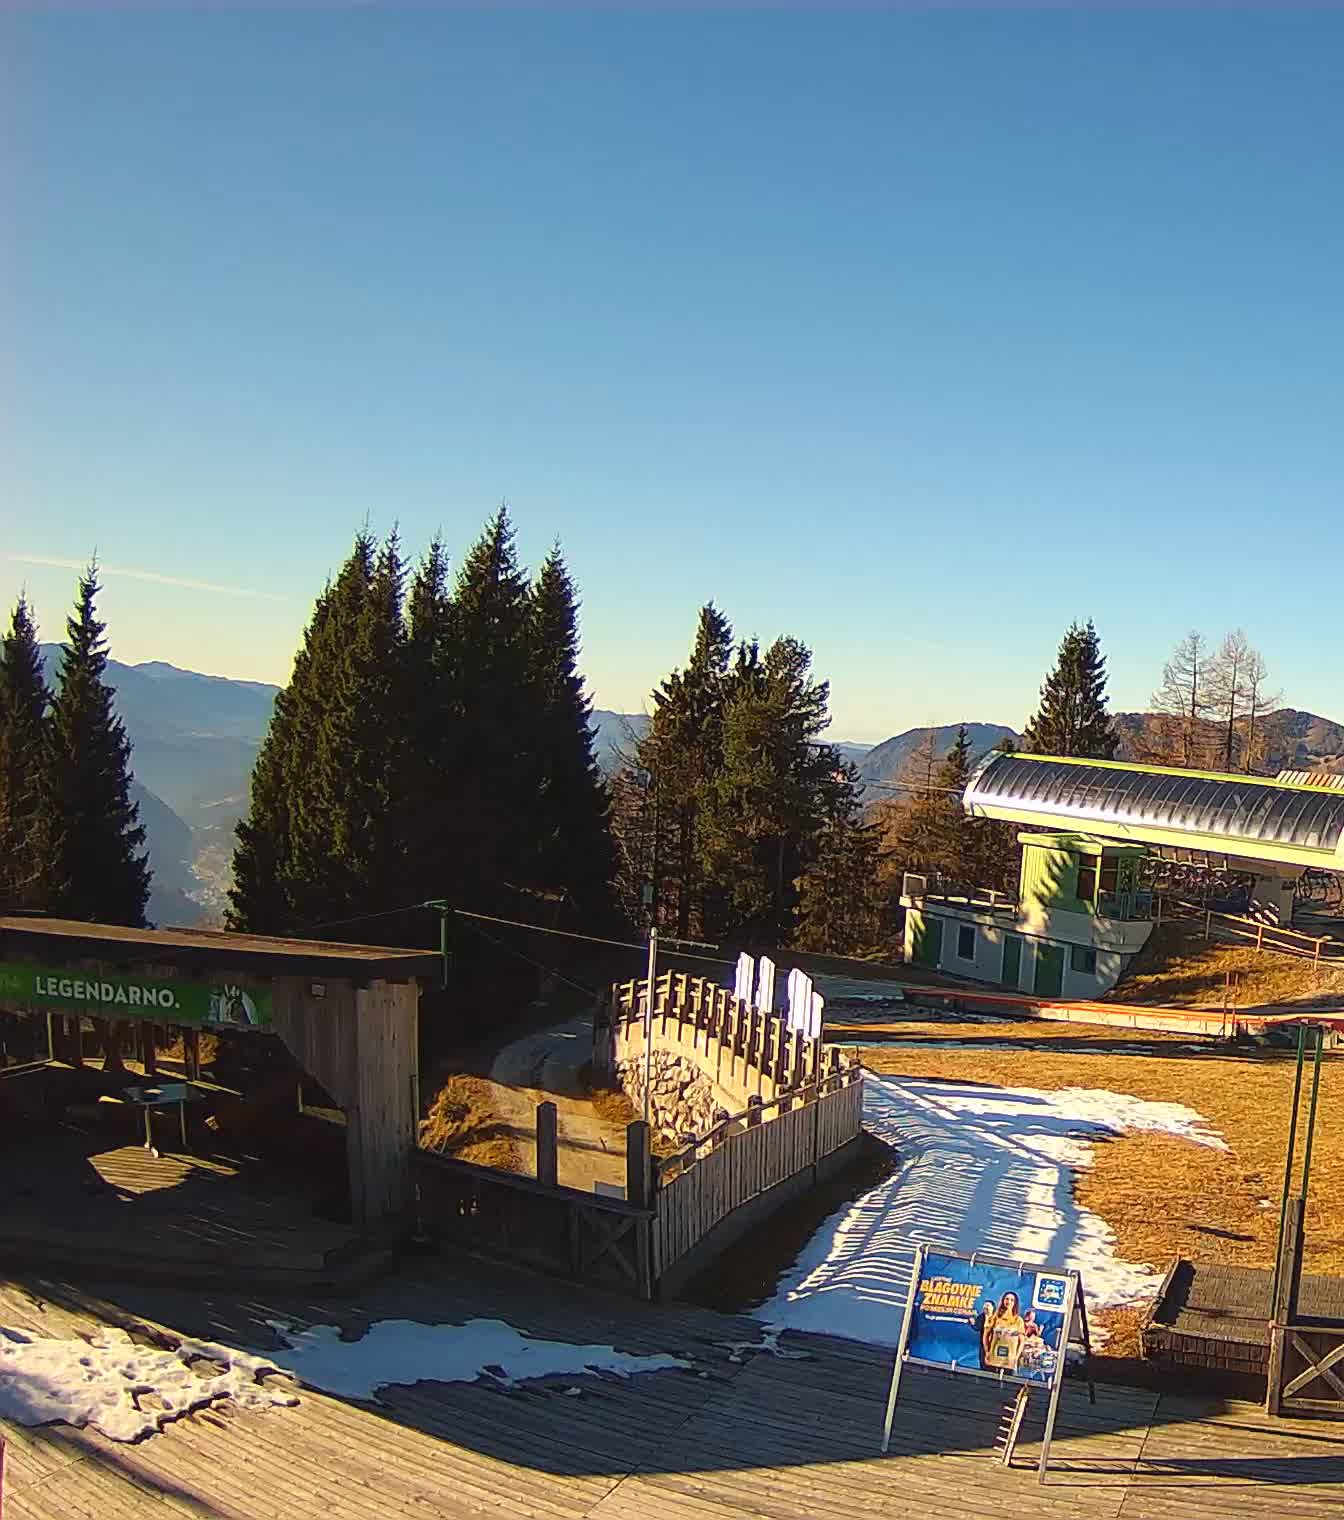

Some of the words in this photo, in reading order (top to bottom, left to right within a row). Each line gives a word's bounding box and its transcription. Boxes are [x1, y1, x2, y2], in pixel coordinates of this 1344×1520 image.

[35, 976, 180, 1009] LEGENDARNO.
[920, 1279, 983, 1297] BLAGOVNE
[922, 1293, 977, 1309] ZNAMKE
